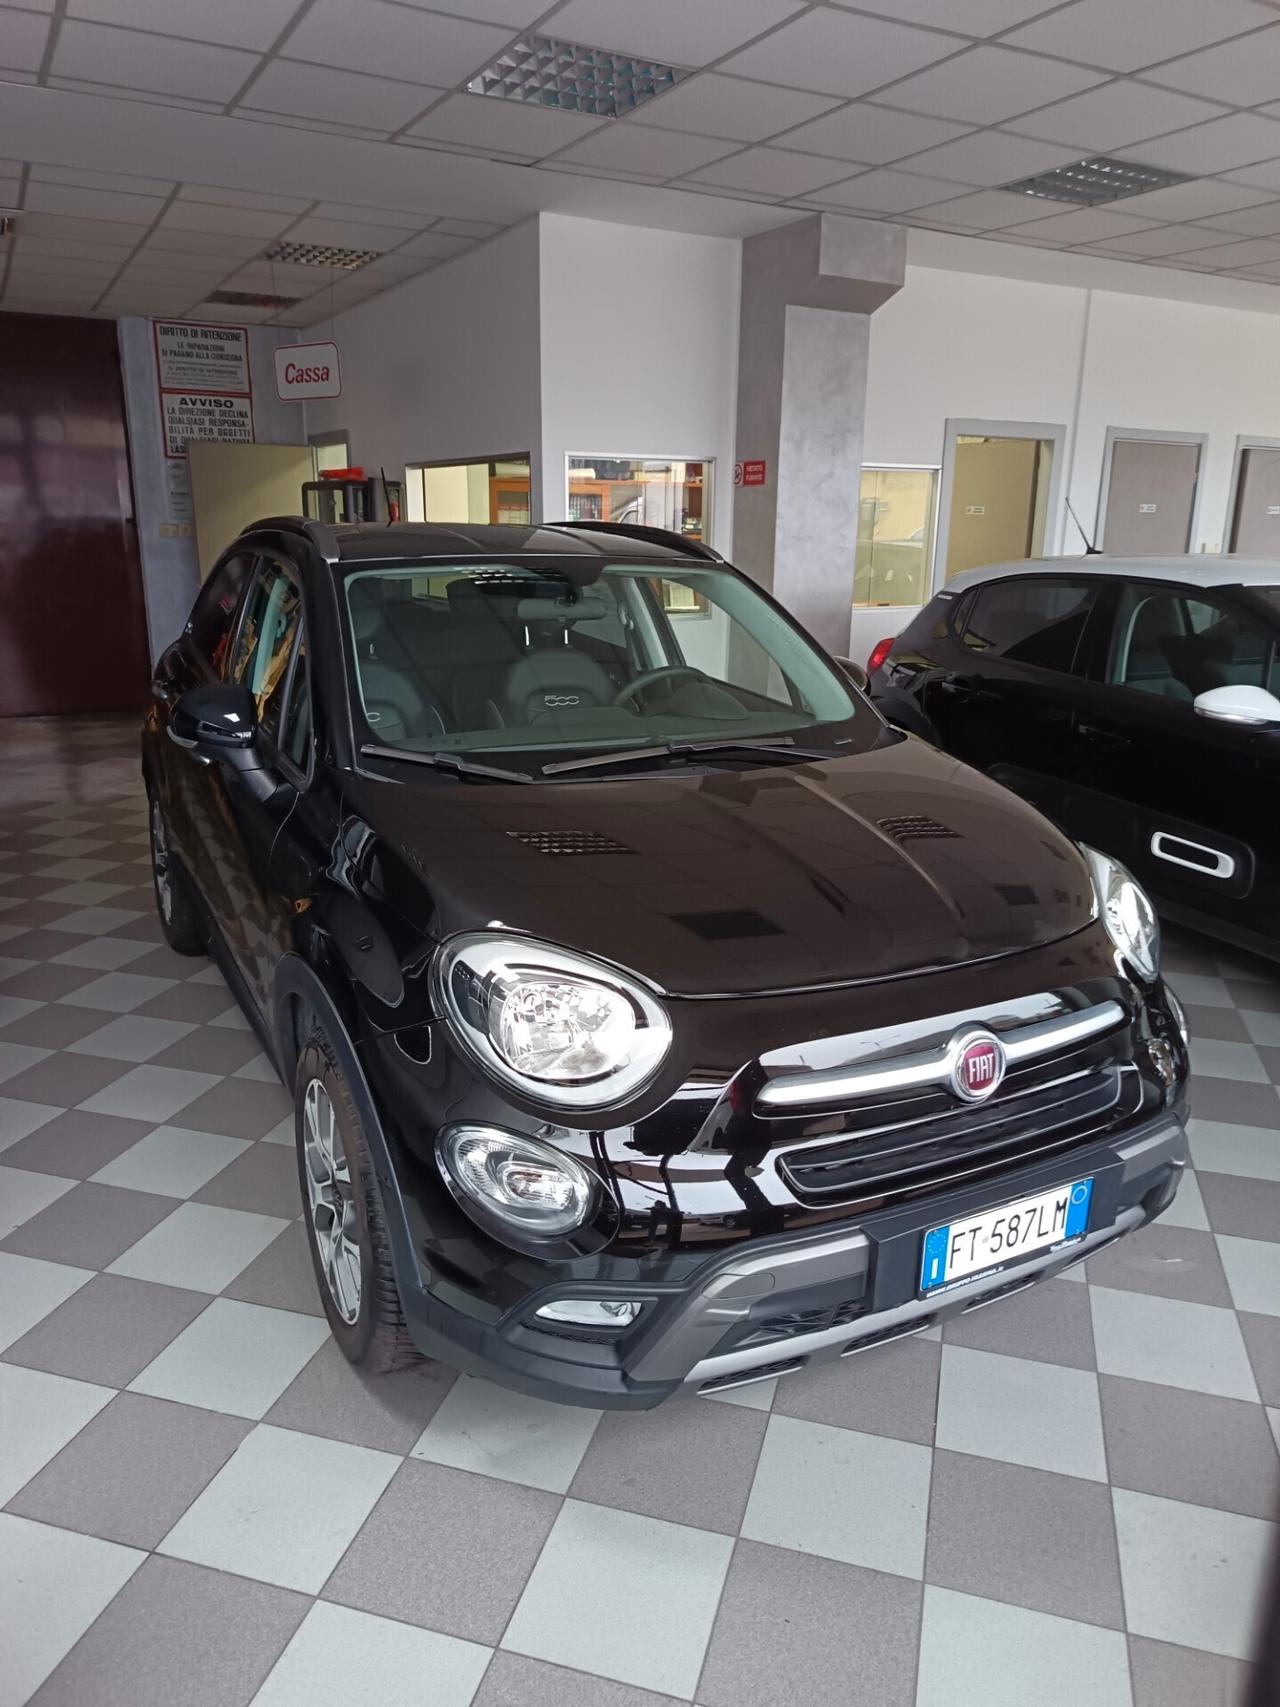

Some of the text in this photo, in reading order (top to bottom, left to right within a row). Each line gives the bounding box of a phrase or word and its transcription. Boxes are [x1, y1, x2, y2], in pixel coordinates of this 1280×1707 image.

[160, 326, 242, 342] DIRITTO DI RITENZIONE
[196, 351, 209, 360] ALLA
[285, 363, 330, 384] Cassa
[179, 397, 234, 409] AVVISO
[167, 406, 248, 418] LA DIREZIONE DECLINA
[168, 416, 249, 428] QUALSIASI RESPONSA-
[168, 425, 250, 438] BILITÀ PER OGGETTI
[968, 1053, 994, 1084] FIAT
[949, 1197, 1068, 1269] FT 587LM
